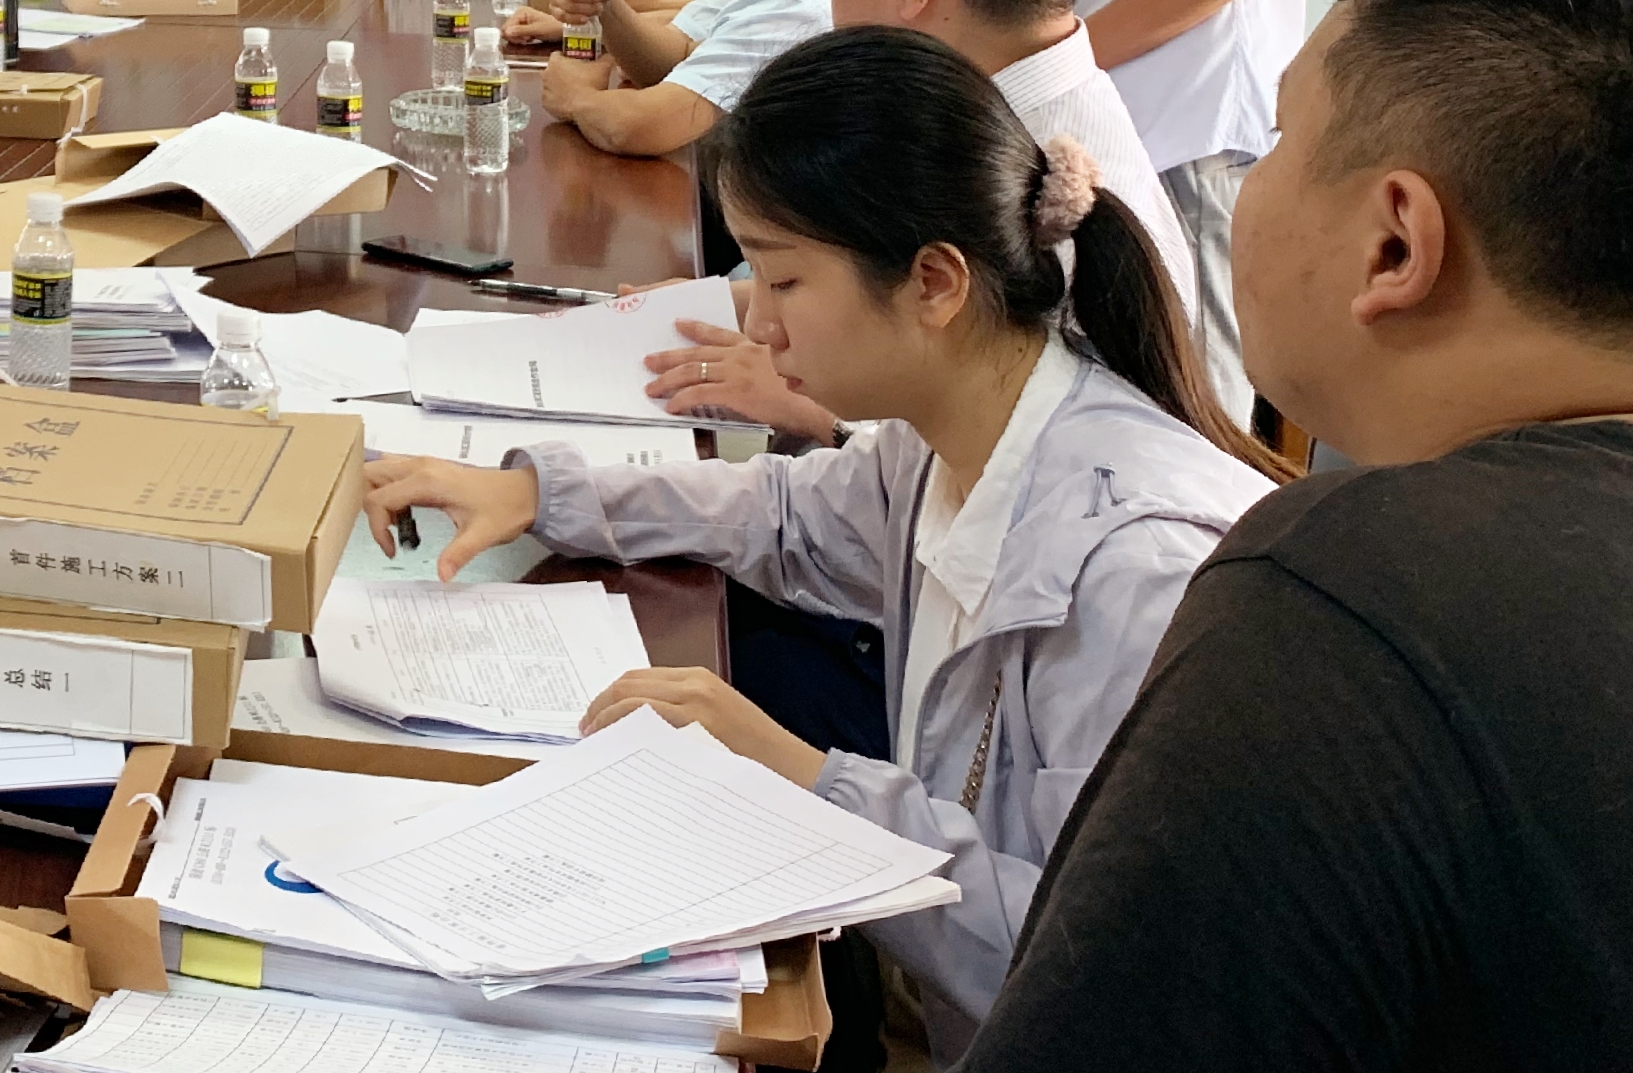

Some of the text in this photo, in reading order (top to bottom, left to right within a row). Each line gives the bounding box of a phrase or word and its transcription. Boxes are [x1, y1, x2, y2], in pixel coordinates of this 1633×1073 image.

[9, 548, 184, 588] 首件施工方案二
